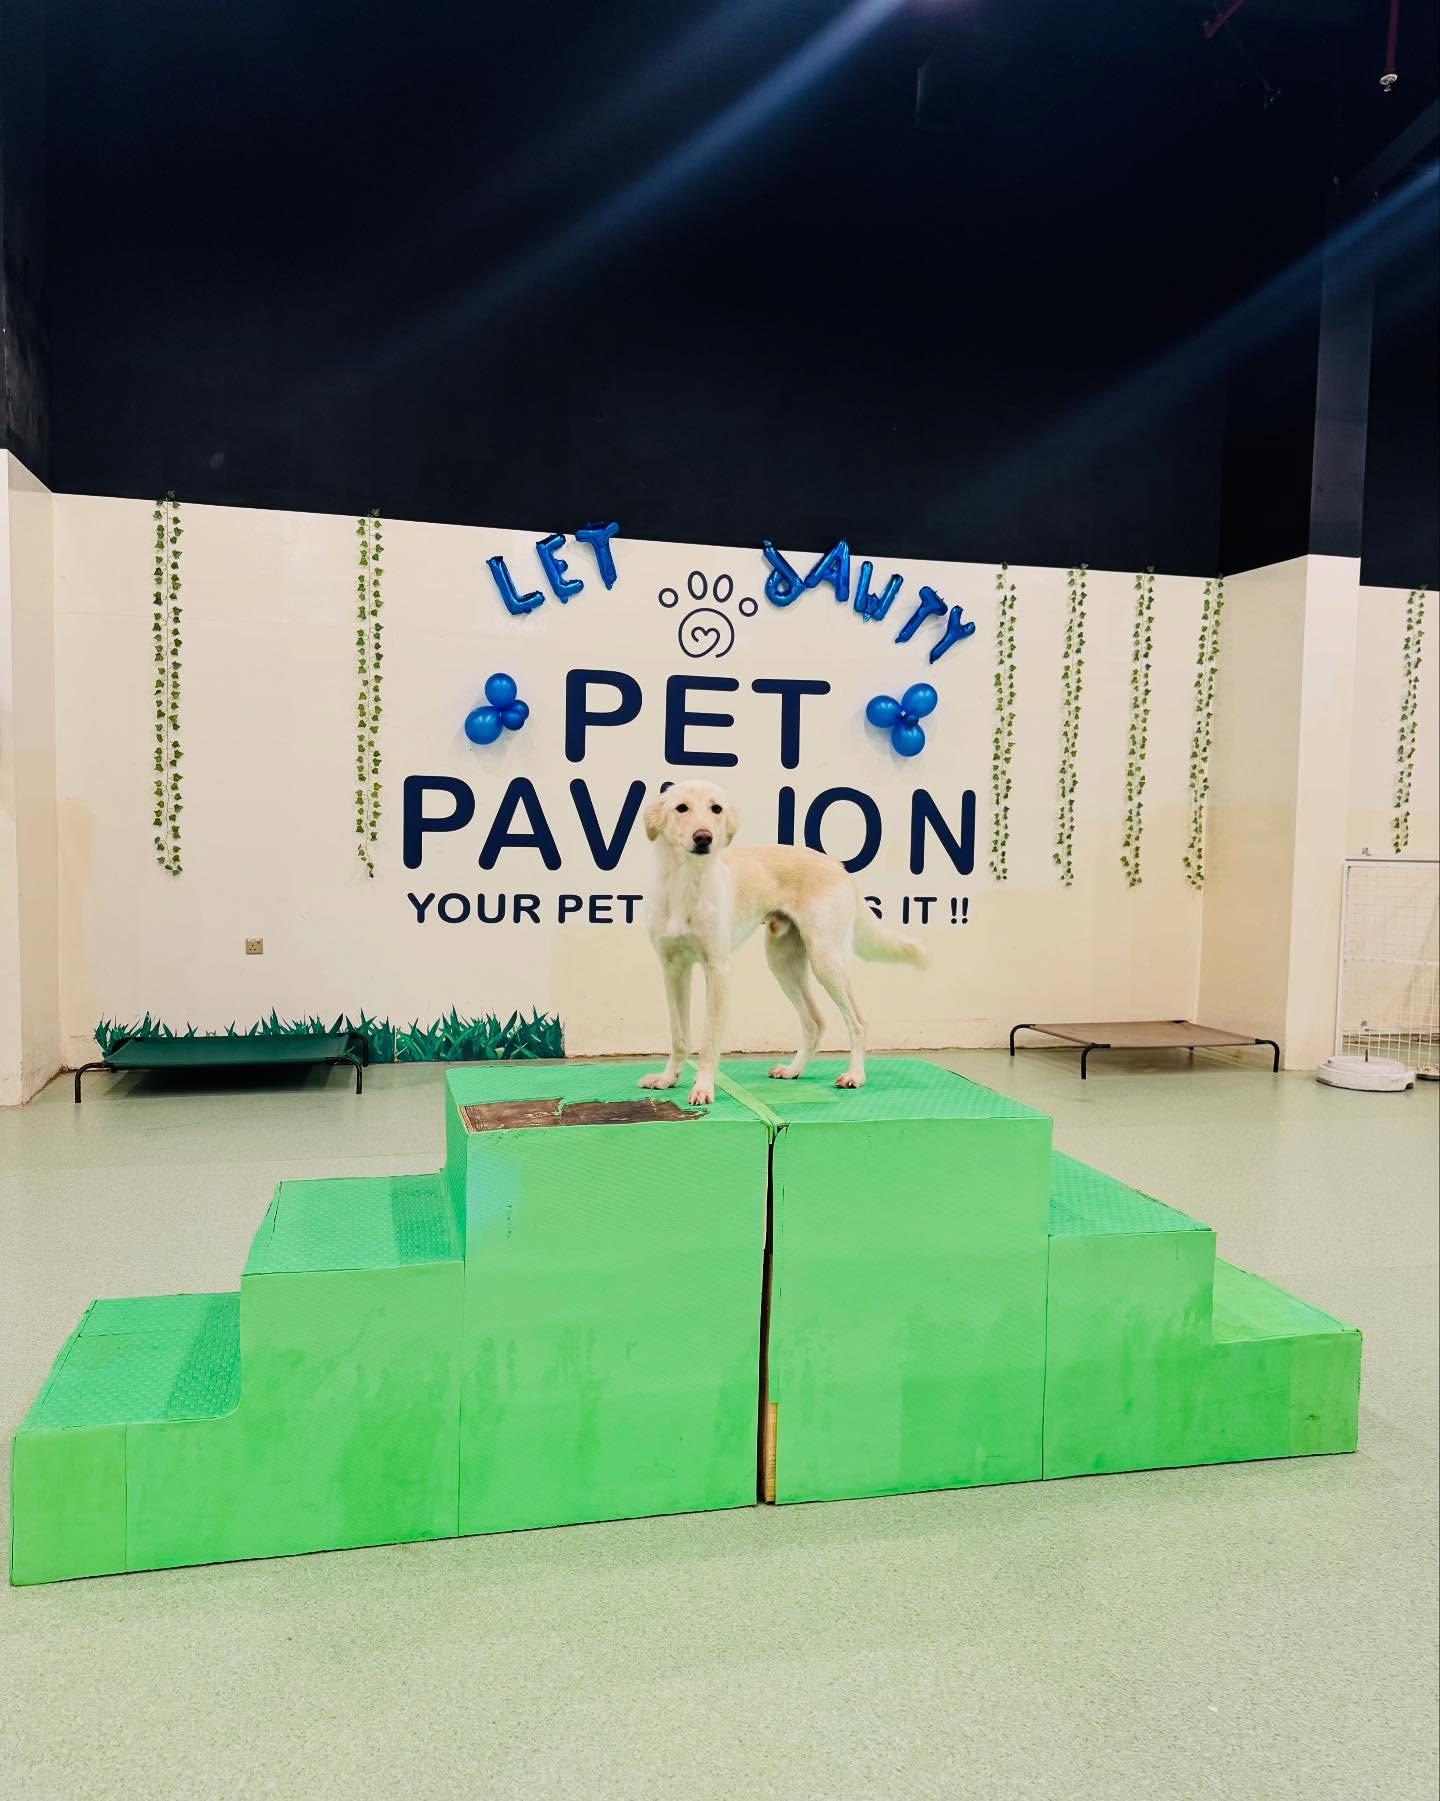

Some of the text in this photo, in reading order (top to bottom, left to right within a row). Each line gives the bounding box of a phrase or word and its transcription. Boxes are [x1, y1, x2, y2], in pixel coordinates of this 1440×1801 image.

[486, 520, 621, 615] LET
[565, 668, 831, 769] PET
[403, 775, 977, 876] PAVION
[407, 892, 541, 924] YOUR
[558, 894, 644, 924] PET
[902, 896, 938, 925] IT
